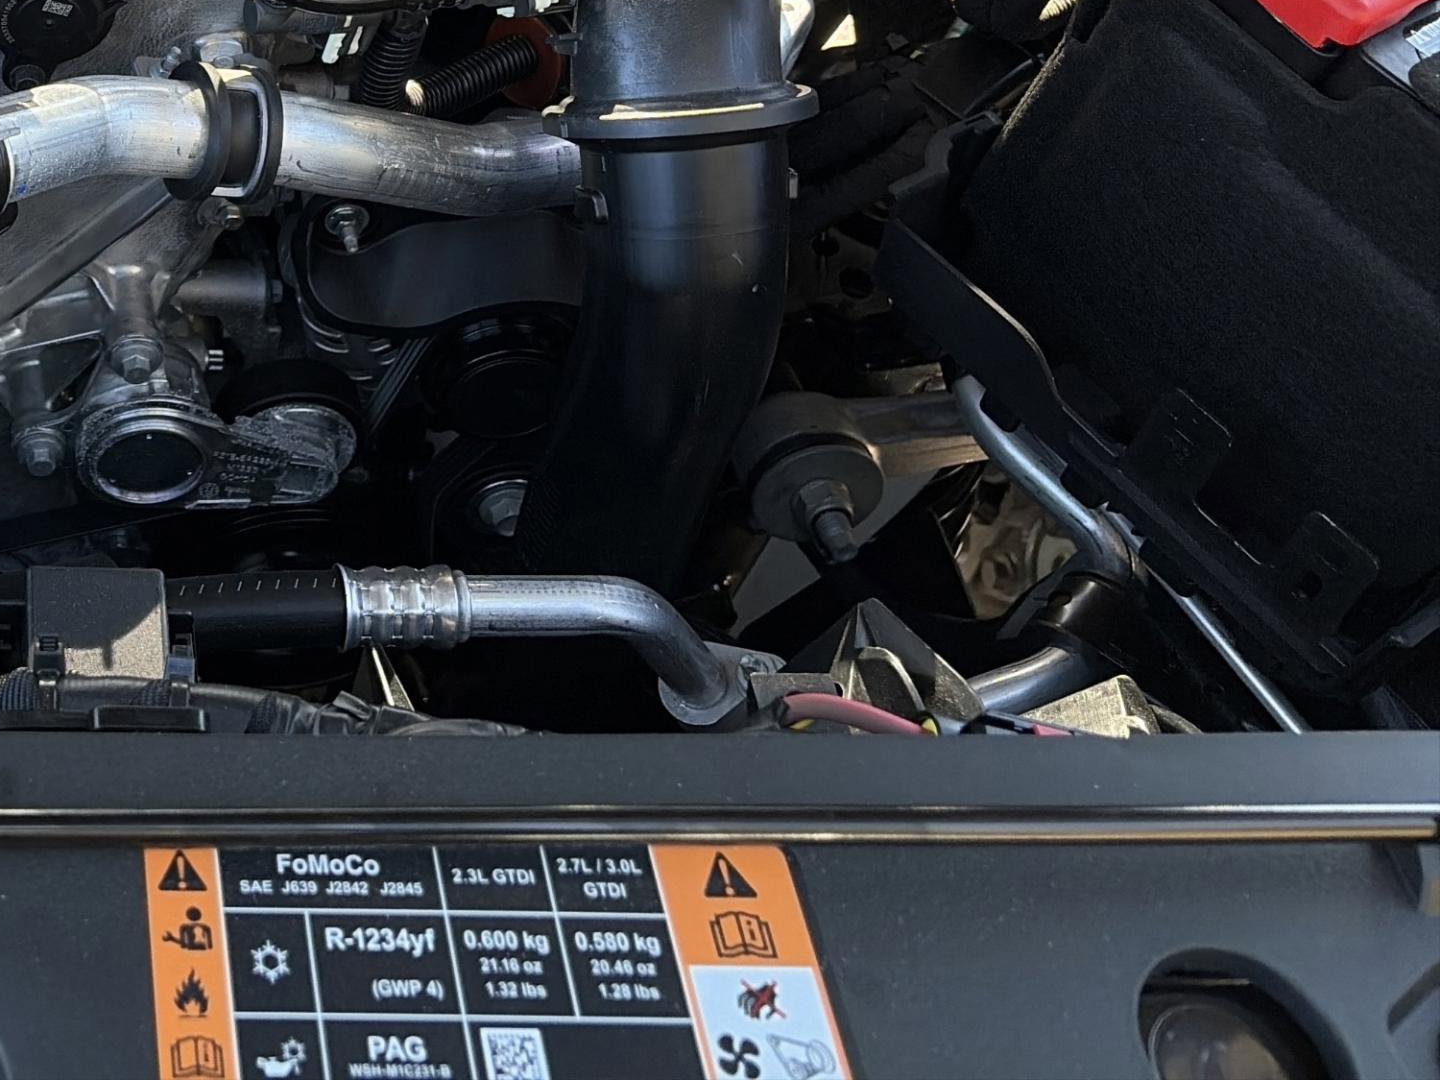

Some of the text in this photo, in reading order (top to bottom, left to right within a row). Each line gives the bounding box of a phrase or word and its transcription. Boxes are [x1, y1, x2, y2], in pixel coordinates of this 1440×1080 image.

[275, 853, 381, 876] FoMoCo
[555, 857, 593, 874] 2.7L
[604, 858, 643, 875] 3.0L
[451, 868, 536, 886] 2.3L GTDI
[239, 879, 423, 897] SAE J639 J2842 J2845
[583, 881, 627, 900] GTDI
[324, 927, 436, 958] R-1234yf
[463, 929, 551, 956] 0.600 kg
[574, 931, 662, 958] 0.580 kg
[523, 960, 543, 975] oz
[636, 962, 657, 977] oz
[371, 978, 445, 1002] (GWP 4)
[484, 981, 548, 999] 1.32 lbs
[598, 983, 661, 1001] 1.28 lbs
[366, 1035, 428, 1063] PAG
